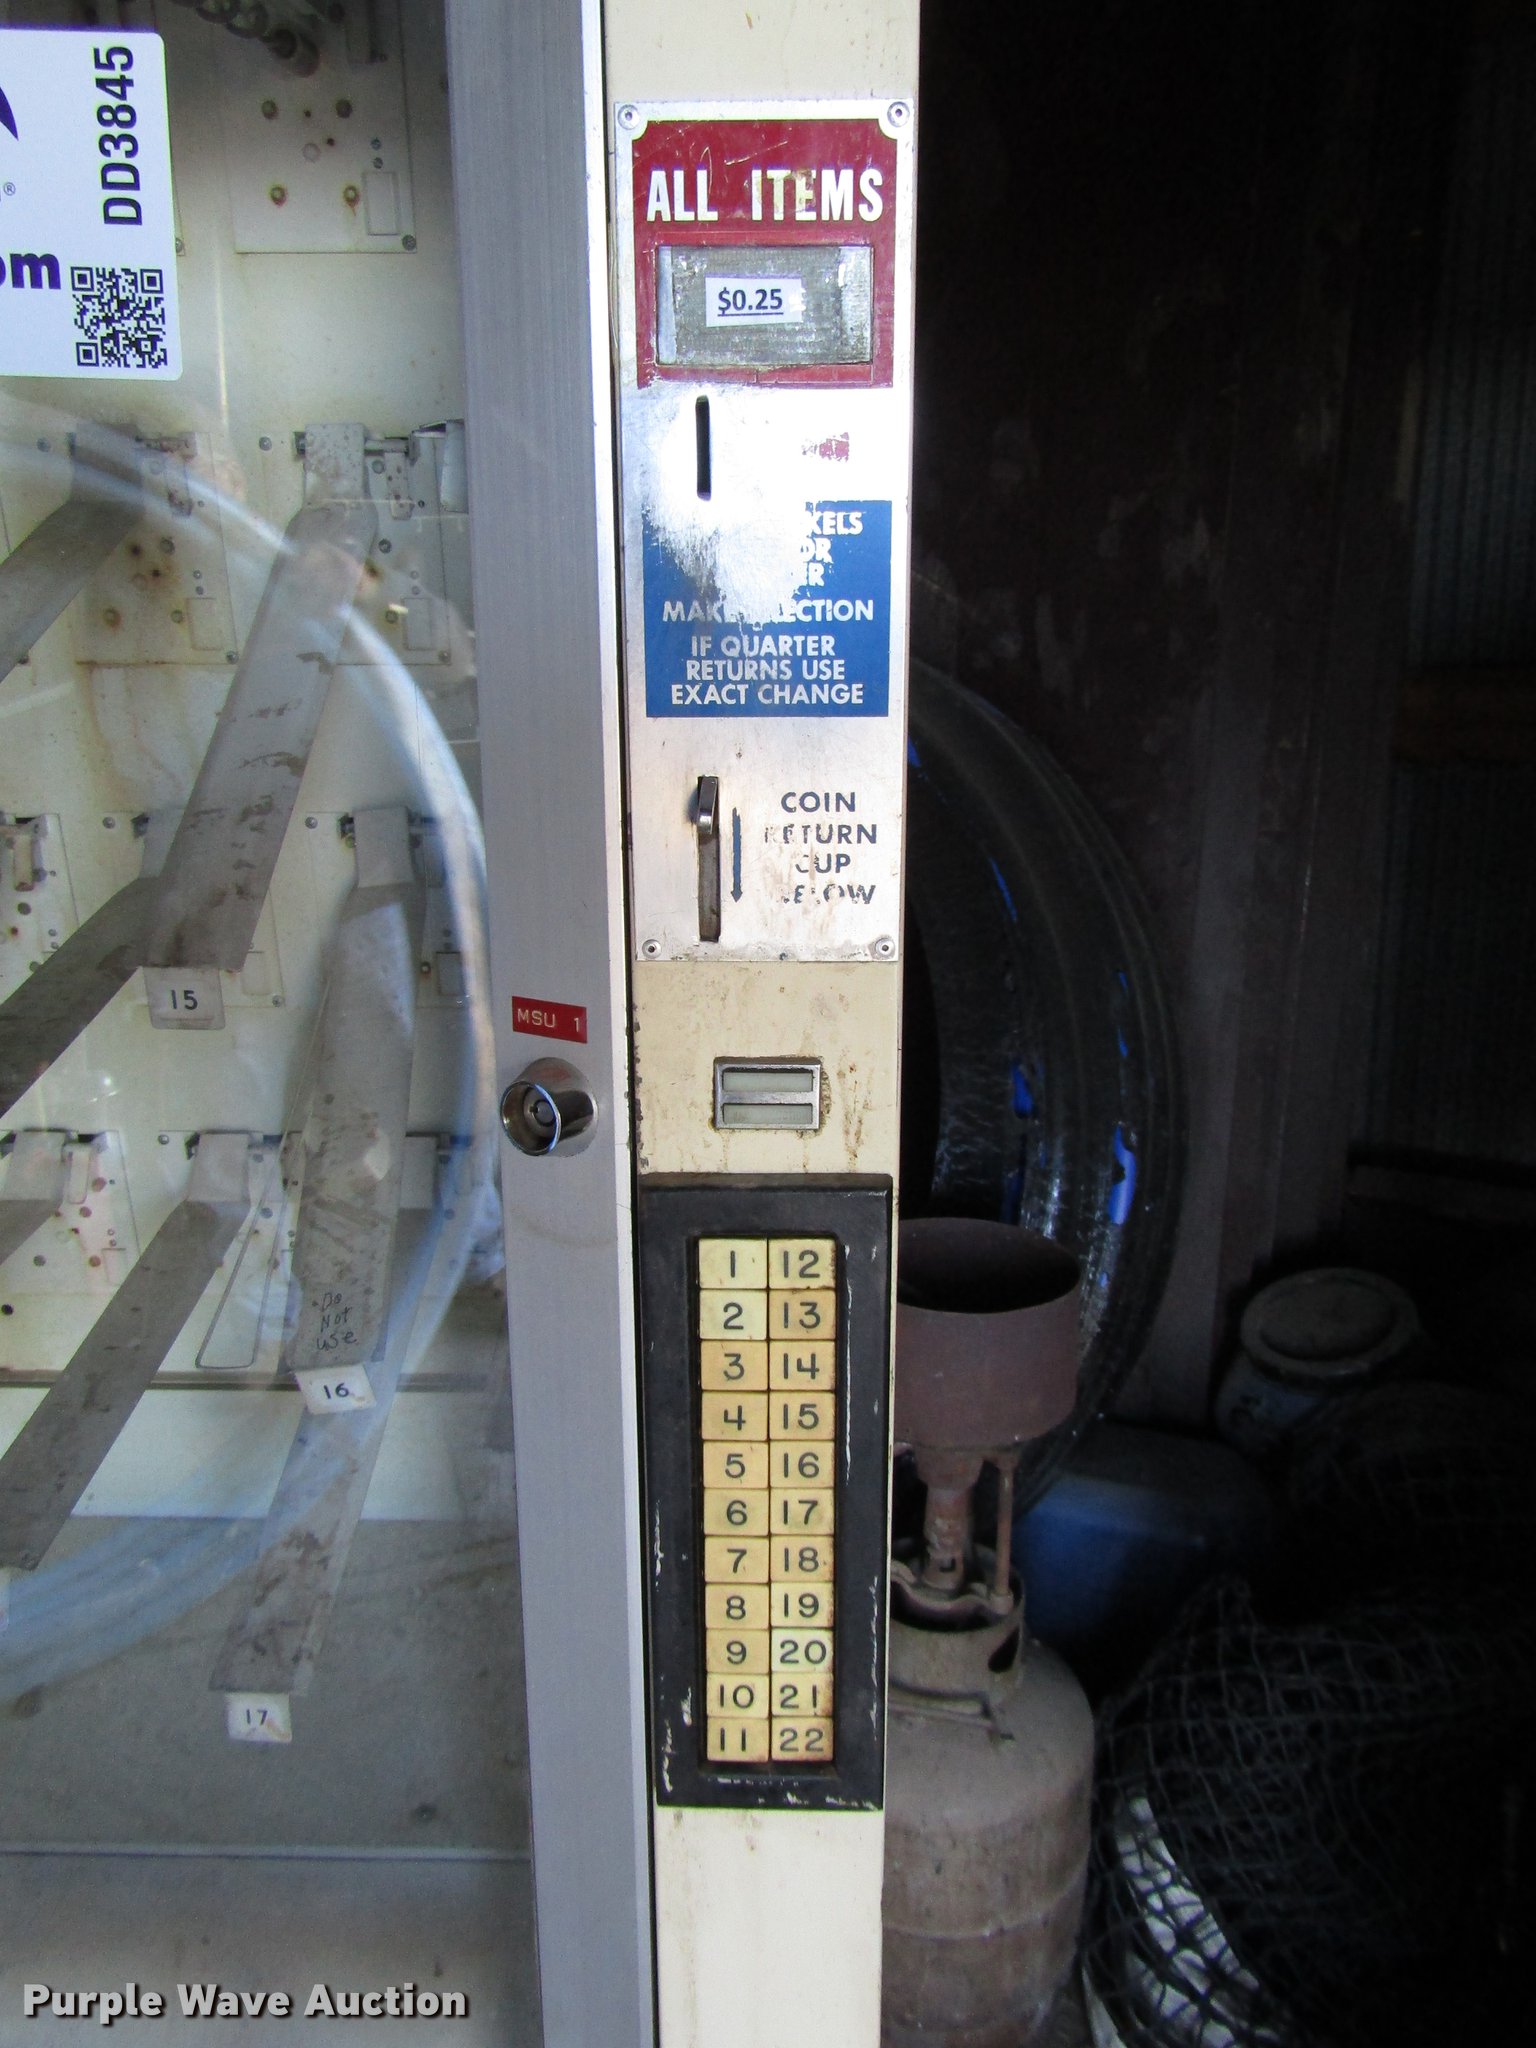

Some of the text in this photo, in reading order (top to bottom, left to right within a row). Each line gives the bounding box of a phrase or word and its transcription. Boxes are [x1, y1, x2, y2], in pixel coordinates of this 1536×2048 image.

[94, 46, 142, 226] DD3845
[646, 168, 884, 222] ALL ITEMS
[717, 287, 784, 316] $0.25
[691, 634, 836, 658] IF QUARTER
[686, 659, 845, 681] RETURNS USE
[671, 683, 864, 705] EXACT CHANGE
[781, 791, 856, 813] COIN
[170, 989, 198, 1010] 15
[517, 1008, 580, 1033] MSU 1
[729, 1250, 736, 1278] 1
[783, 1249, 821, 1279] 12
[321, 1292, 342, 1313] Do
[783, 1301, 821, 1329] 13
[723, 1302, 744, 1330] 2
[723, 1353, 745, 1381] 3
[783, 1353, 820, 1380] 14
[323, 1382, 350, 1399] 16
[723, 1405, 746, 1431] 4
[783, 1403, 820, 1430] 15
[725, 1453, 746, 1479] 5
[783, 1452, 820, 1479] 16
[726, 1500, 748, 1526] 6
[783, 1500, 819, 1525] 17
[727, 1548, 748, 1574] 7
[784, 1547, 820, 1572] 18
[725, 1595, 747, 1620] 8
[784, 1593, 820, 1618] 19
[726, 1640, 748, 1665] 9
[779, 1639, 827, 1664] 20
[719, 1684, 755, 1709] 10
[779, 1684, 818, 1709] 21
[246, 1708, 268, 1726] 17
[719, 1727, 747, 1752] 11
[779, 1727, 824, 1752] 22
